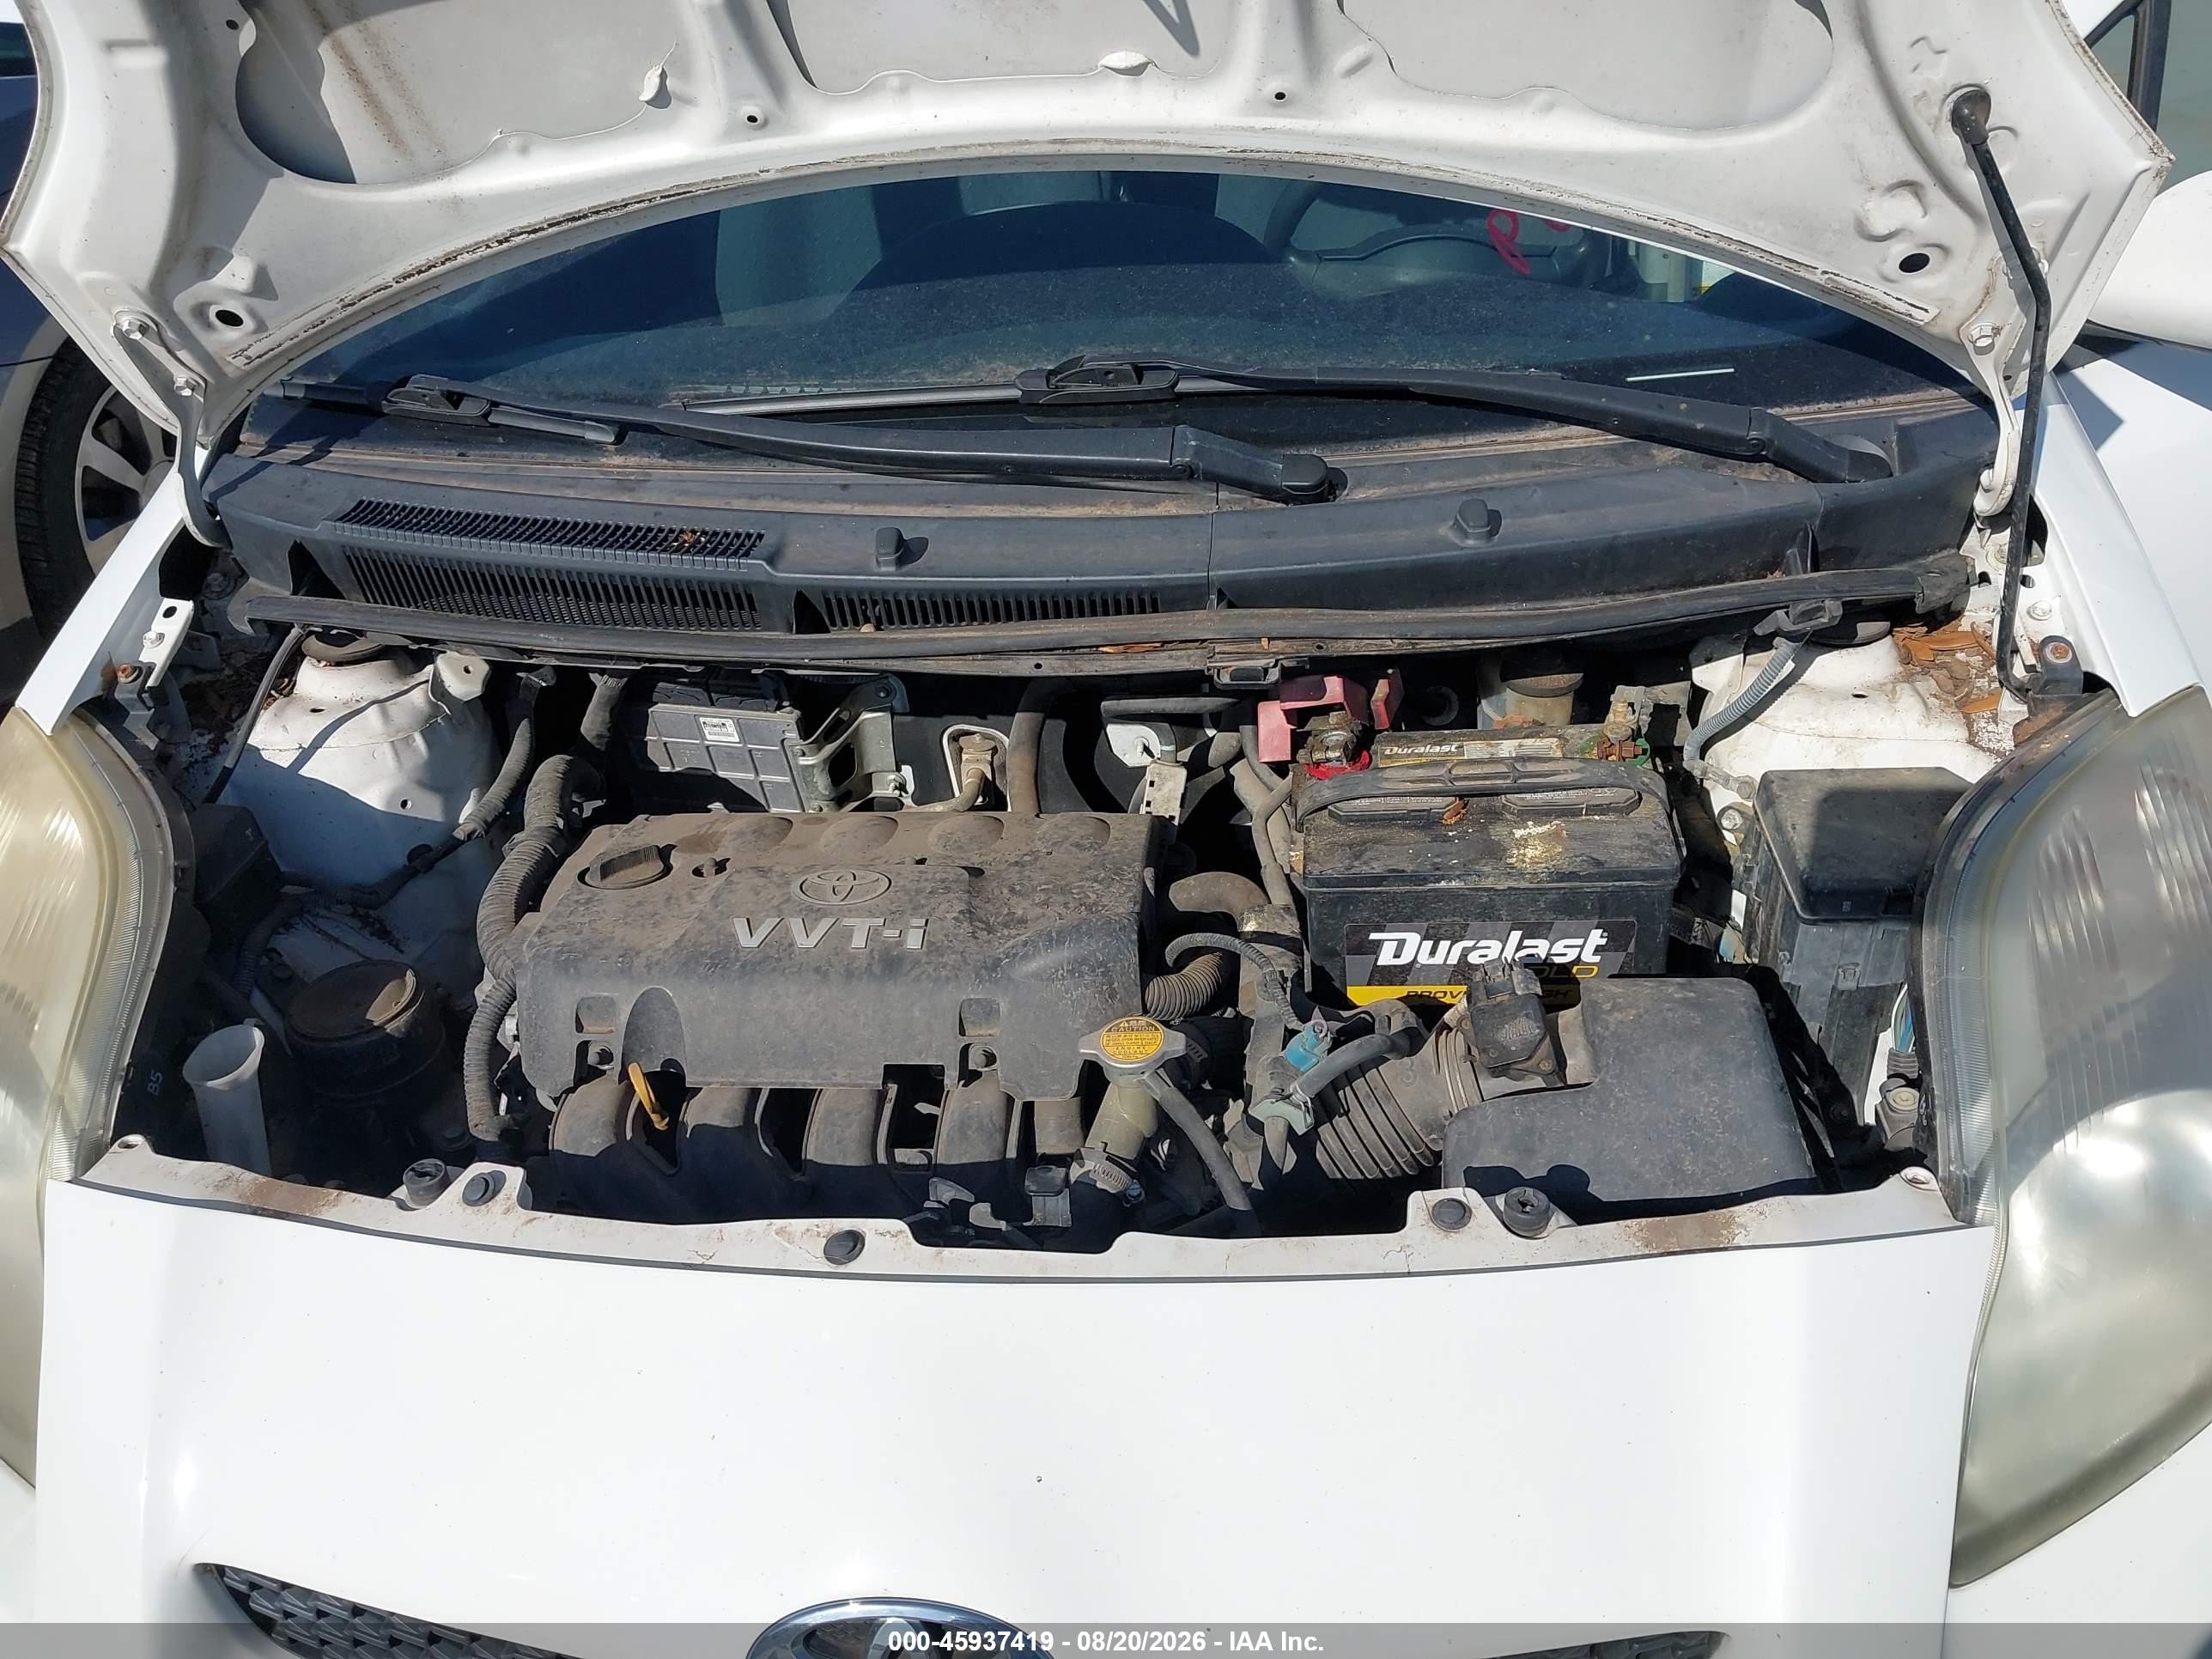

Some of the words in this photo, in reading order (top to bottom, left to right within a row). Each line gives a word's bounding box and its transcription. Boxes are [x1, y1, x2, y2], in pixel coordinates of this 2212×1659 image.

[1381, 744, 1459, 755] Duralast
[732, 916, 929, 949] VVT-i
[1368, 928, 1608, 966] Duralast
